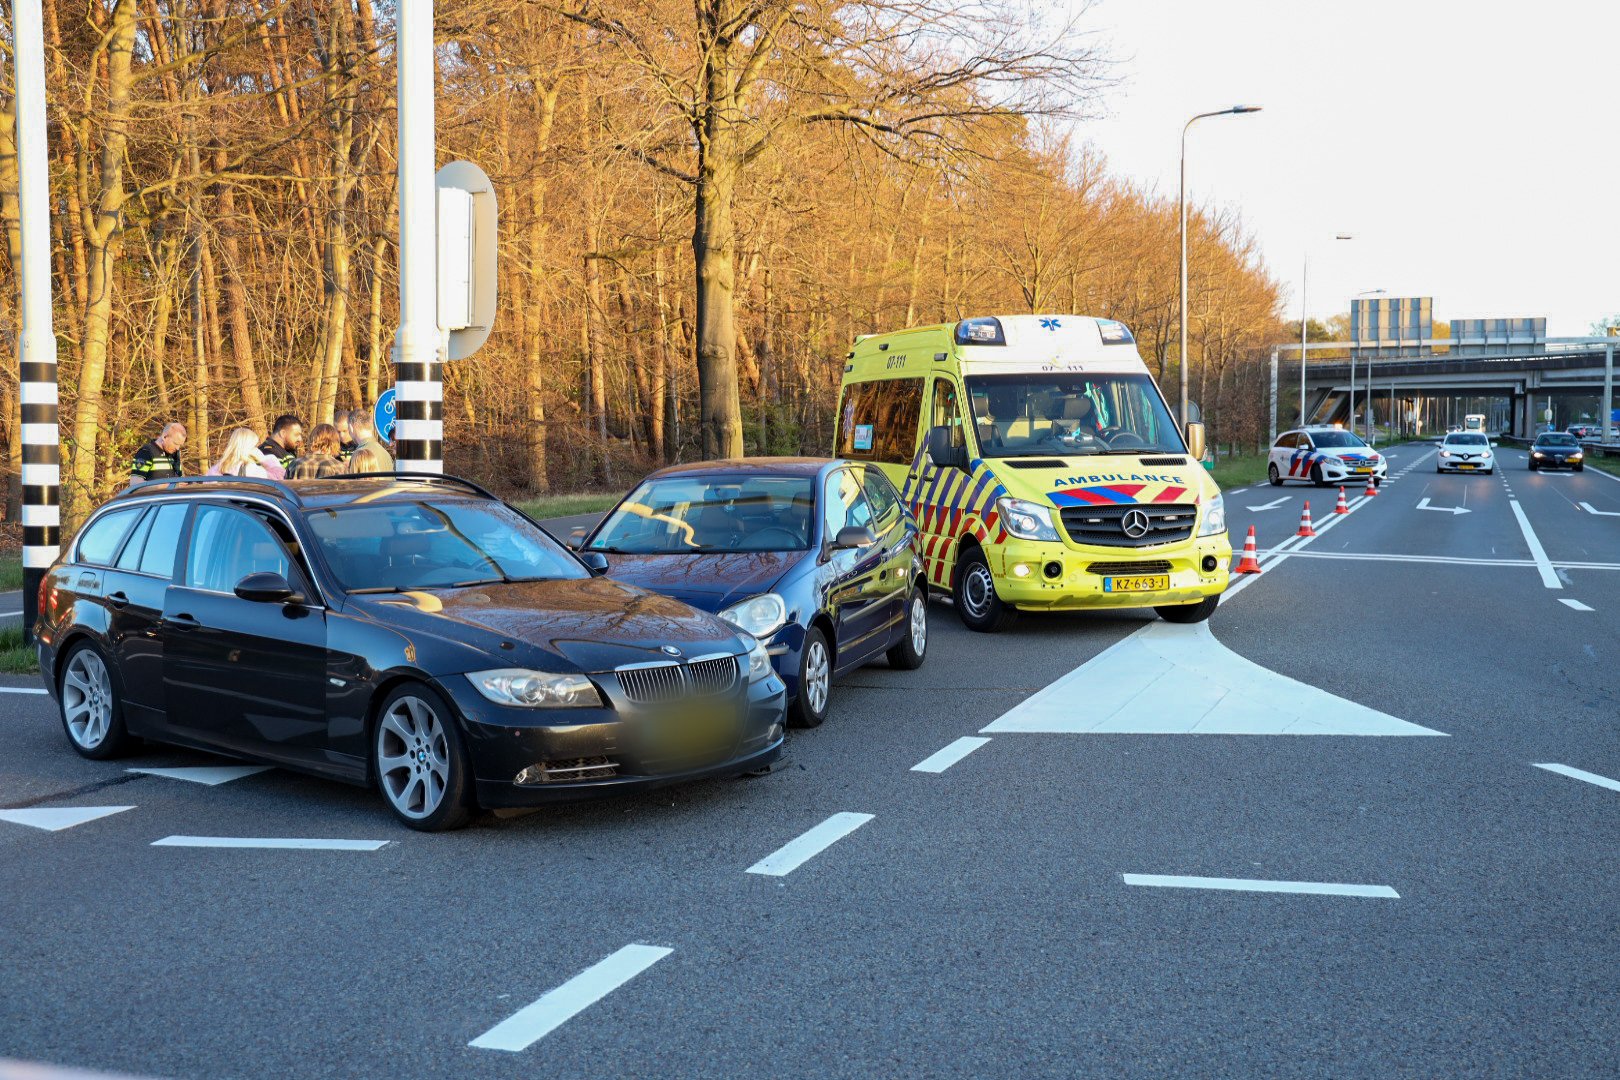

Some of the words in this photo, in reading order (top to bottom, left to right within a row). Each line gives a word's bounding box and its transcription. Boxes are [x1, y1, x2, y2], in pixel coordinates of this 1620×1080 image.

[885, 354, 907, 369] 07-111
[1054, 473, 1185, 487] AMBULANCE
[1116, 577, 1164, 590] KZ-663-J
